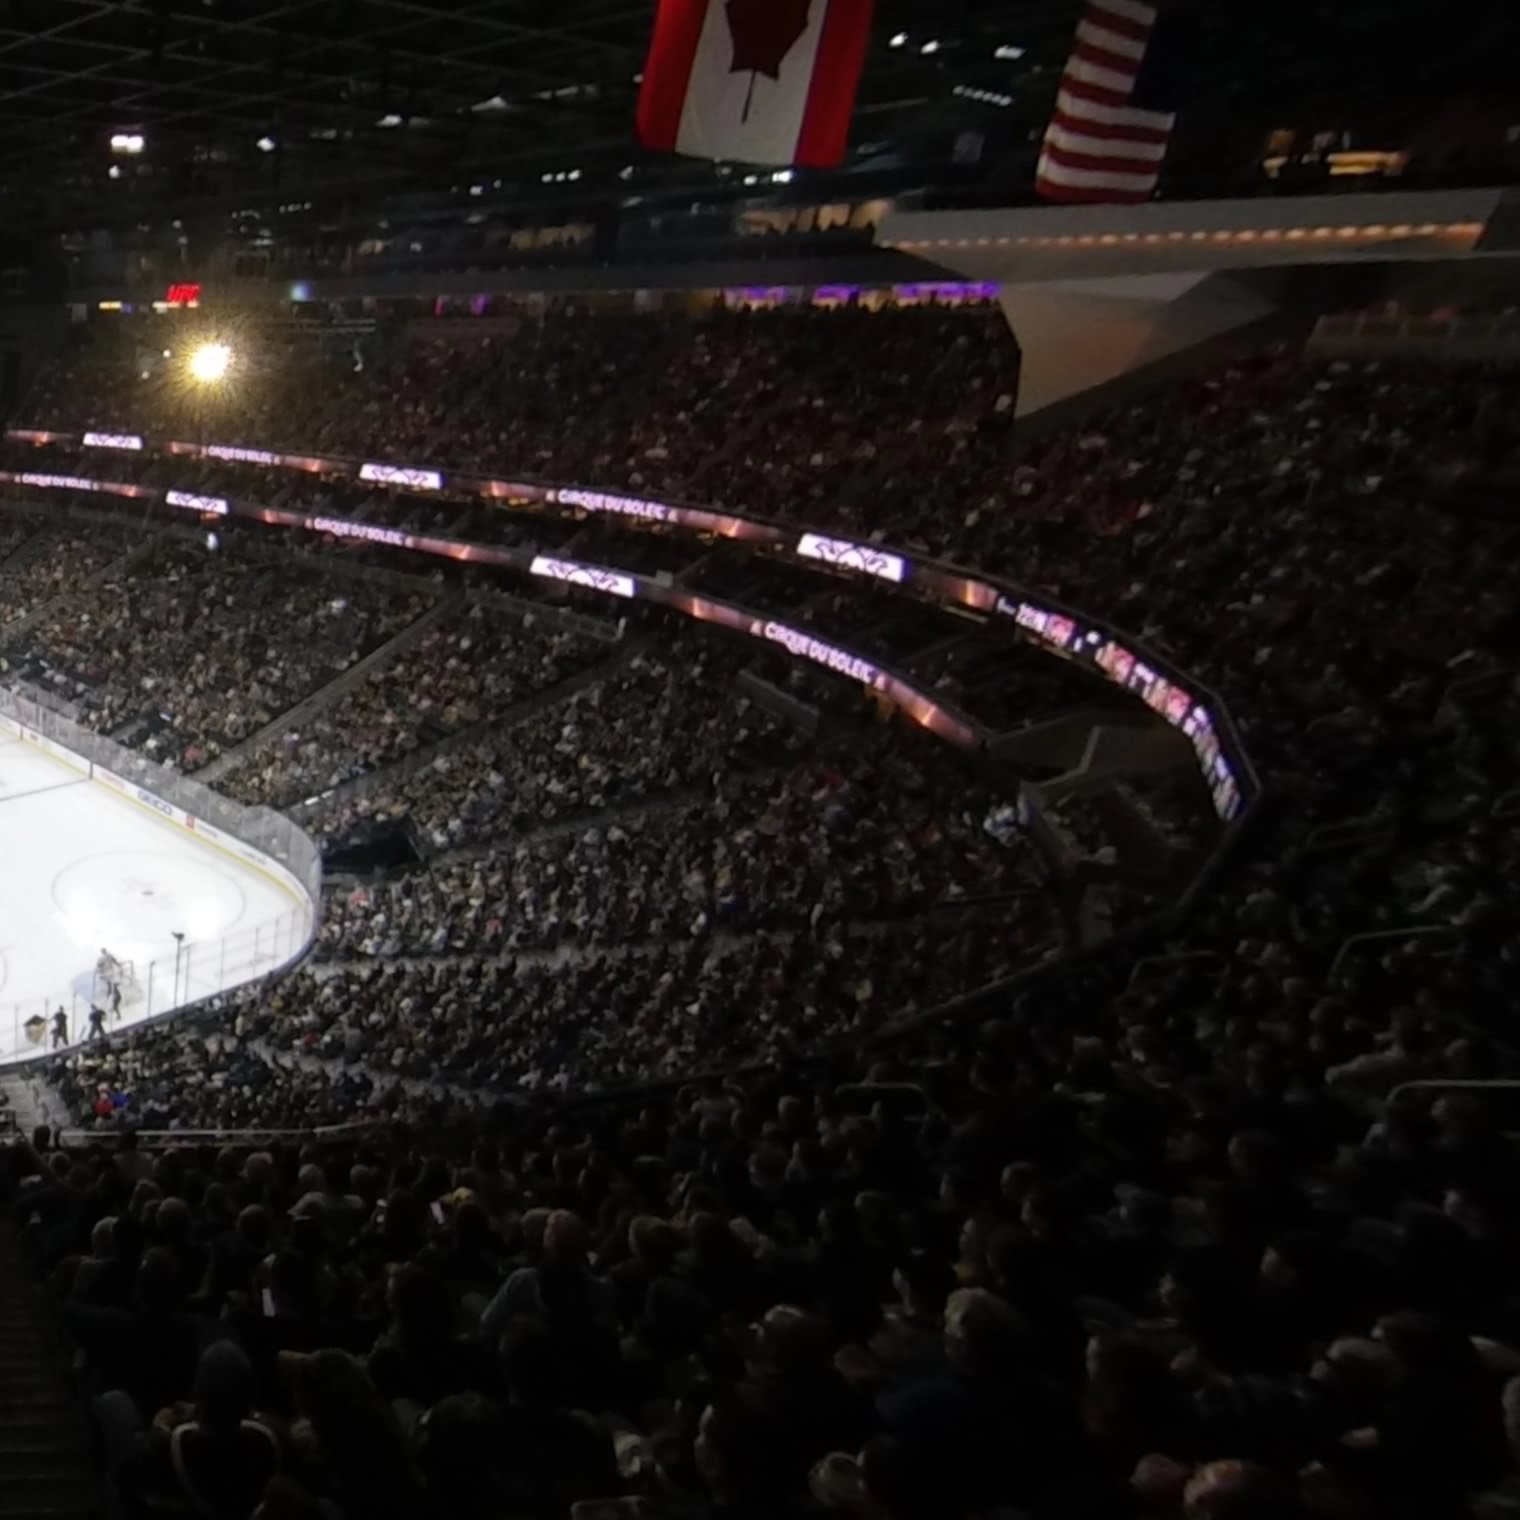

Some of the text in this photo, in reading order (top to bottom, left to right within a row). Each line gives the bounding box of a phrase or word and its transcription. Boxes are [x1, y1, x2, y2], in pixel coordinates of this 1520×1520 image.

[559, 488, 666, 520] CIRQUE DU SOLEIL
[764, 621, 875, 684] CIRQUE DU SOLEIL
[138, 791, 173, 815] GEICO
